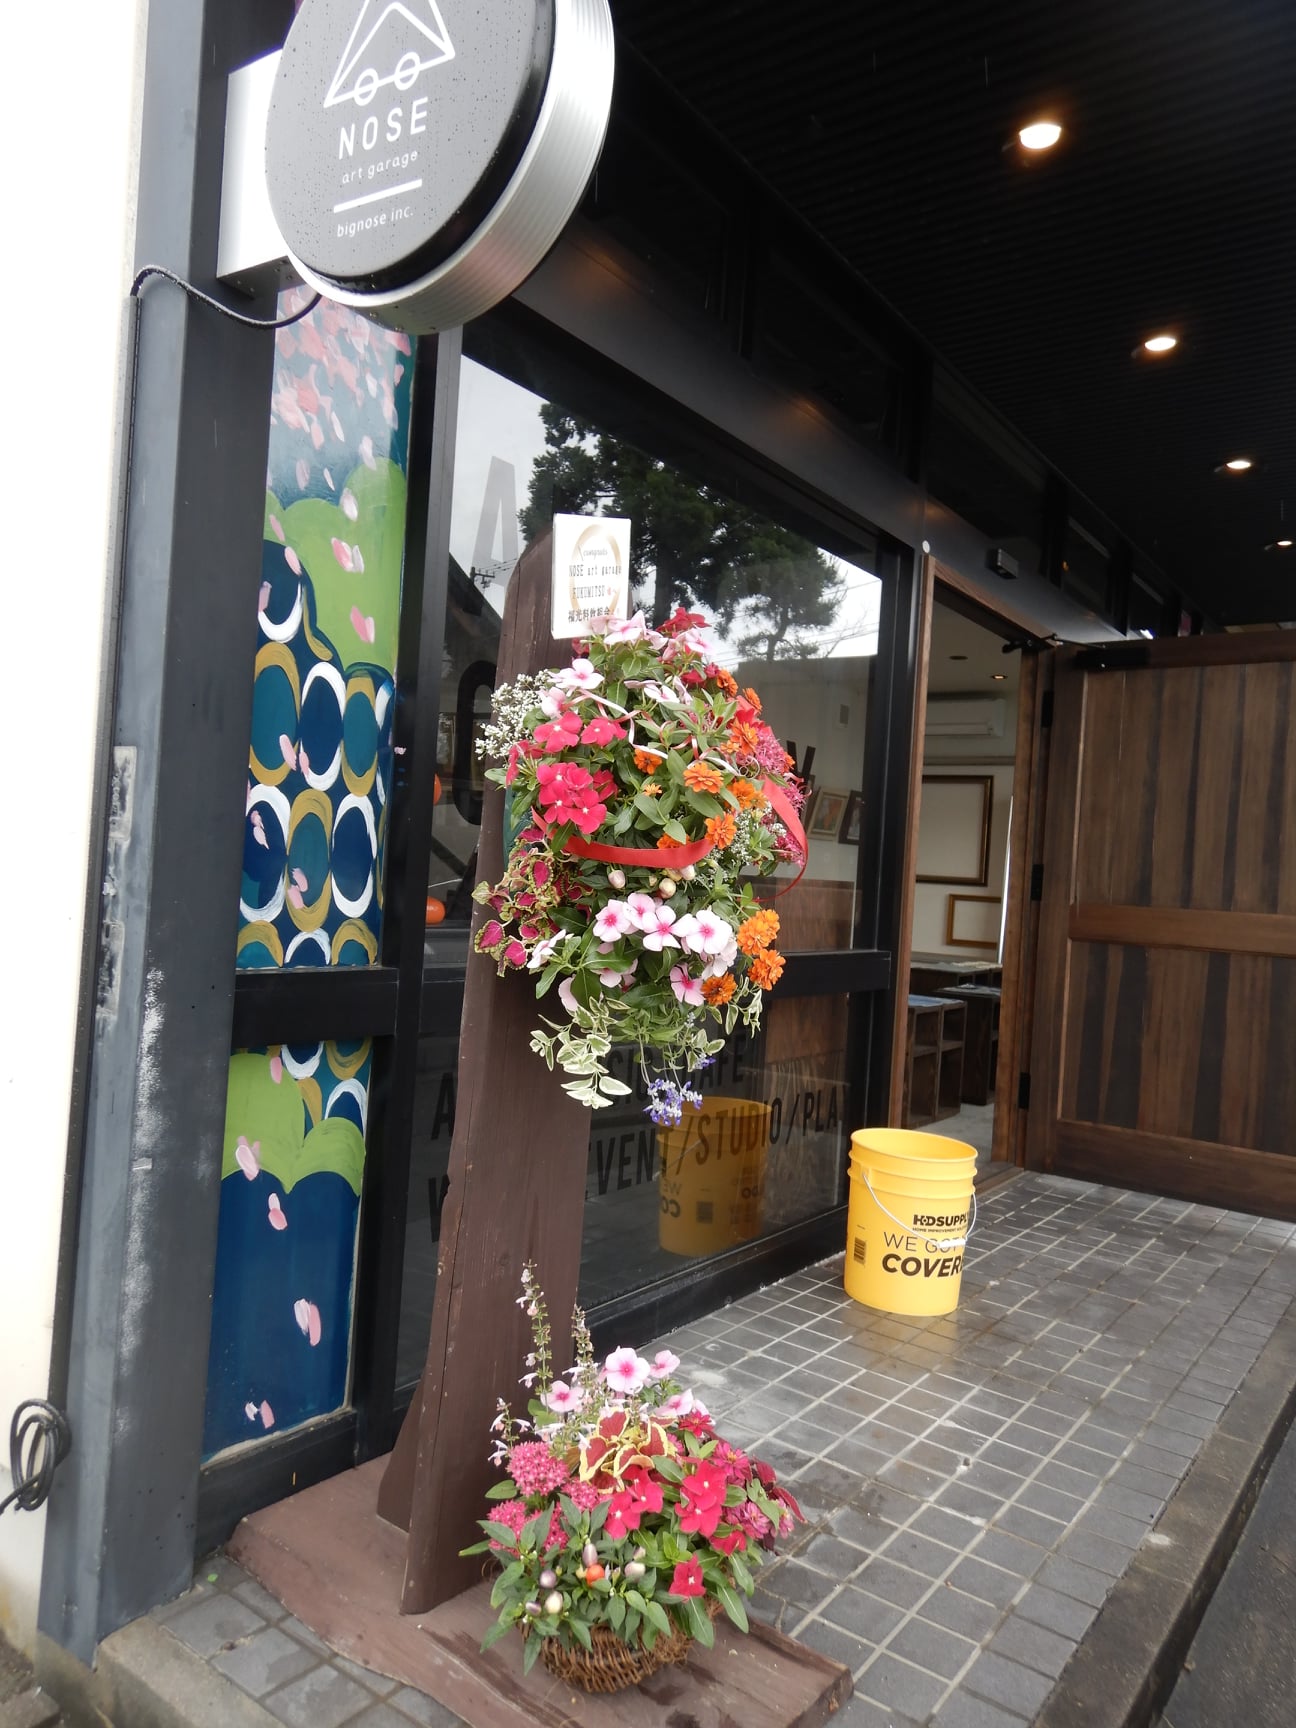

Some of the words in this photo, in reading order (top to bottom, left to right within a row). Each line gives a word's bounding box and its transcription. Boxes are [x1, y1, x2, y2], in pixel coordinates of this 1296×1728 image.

[338, 96, 428, 160] NOSE
[342, 167, 363, 184] art
[367, 150, 418, 179] garage
[336, 213, 387, 238] bignose
[391, 206, 414, 222] inc.
[569, 564, 584, 577] NOSE
[883, 1231, 918, 1252] WE
